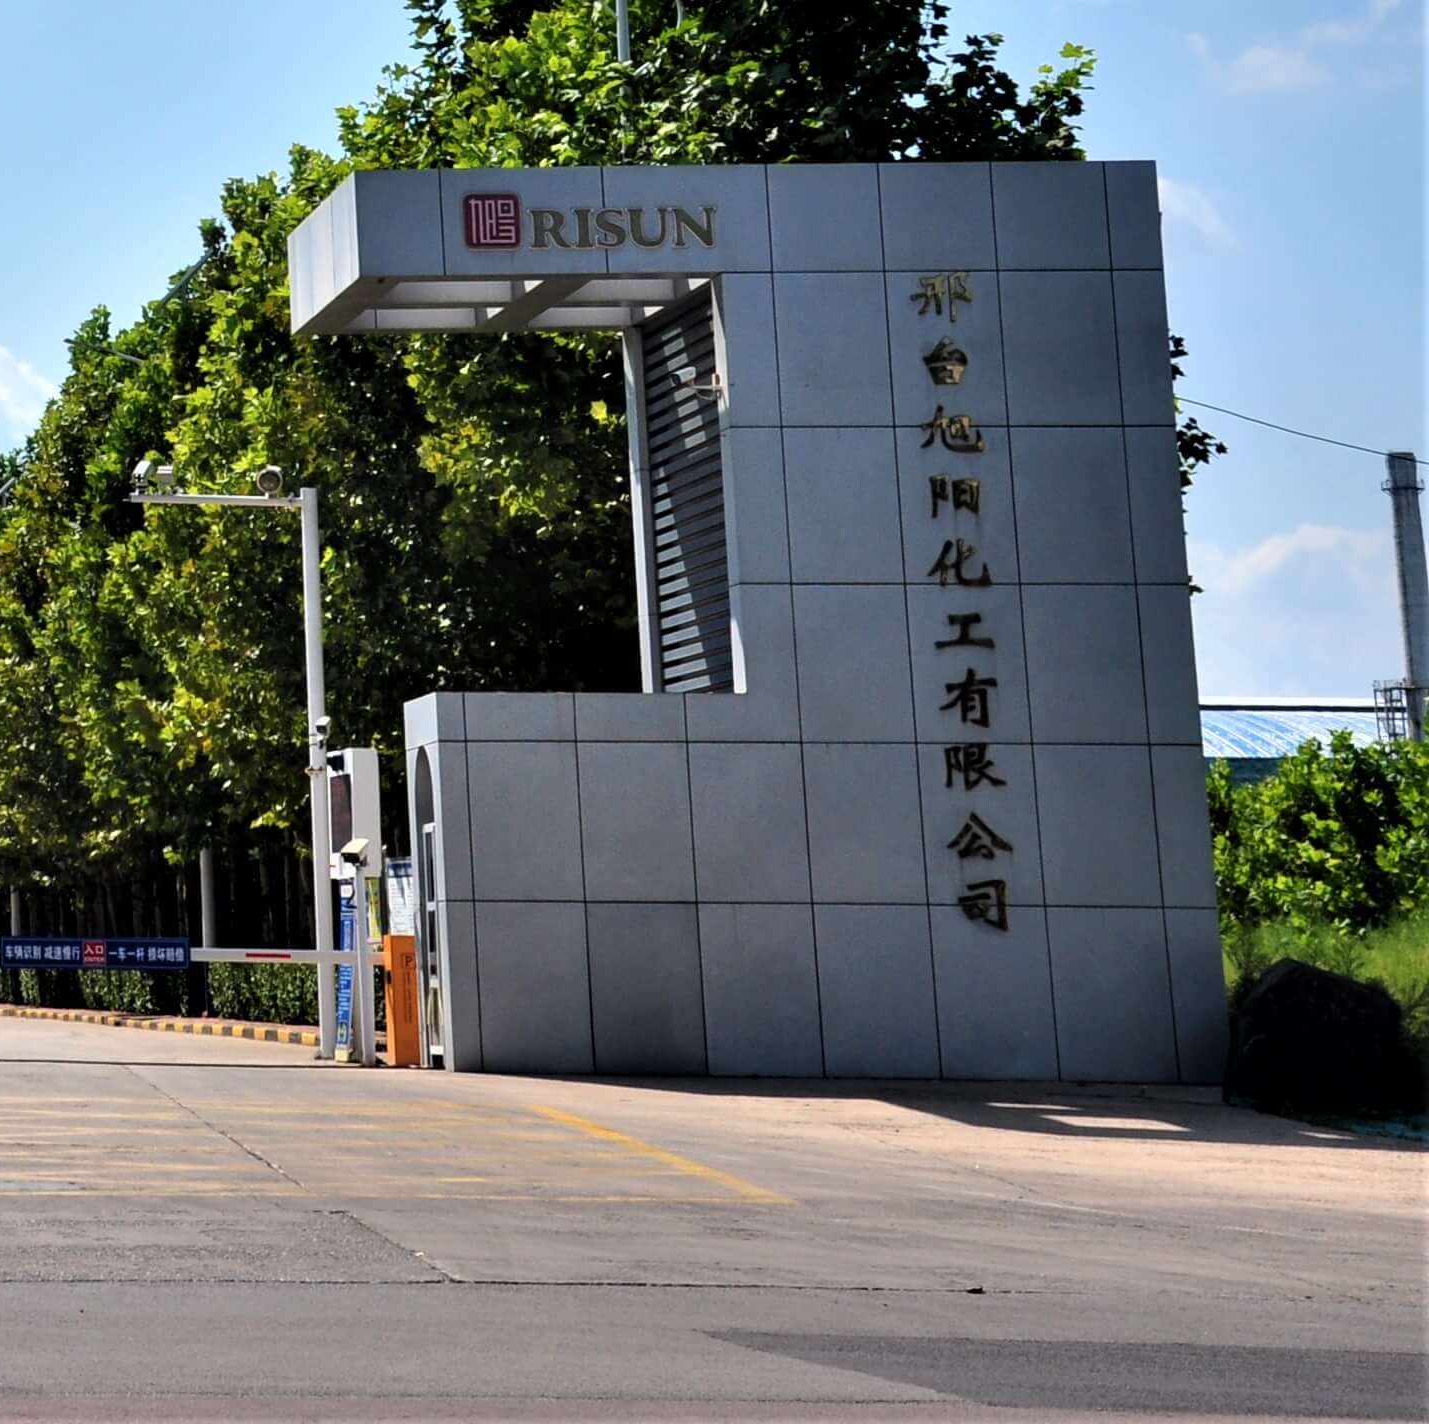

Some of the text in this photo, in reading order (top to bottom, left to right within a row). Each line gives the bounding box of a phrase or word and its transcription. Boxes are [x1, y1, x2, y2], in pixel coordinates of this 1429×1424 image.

[530, 206, 716, 249] RISUN
[909, 271, 1014, 934] 邢台旭阳化工有限公司
[84, 944, 105, 955] 入口
